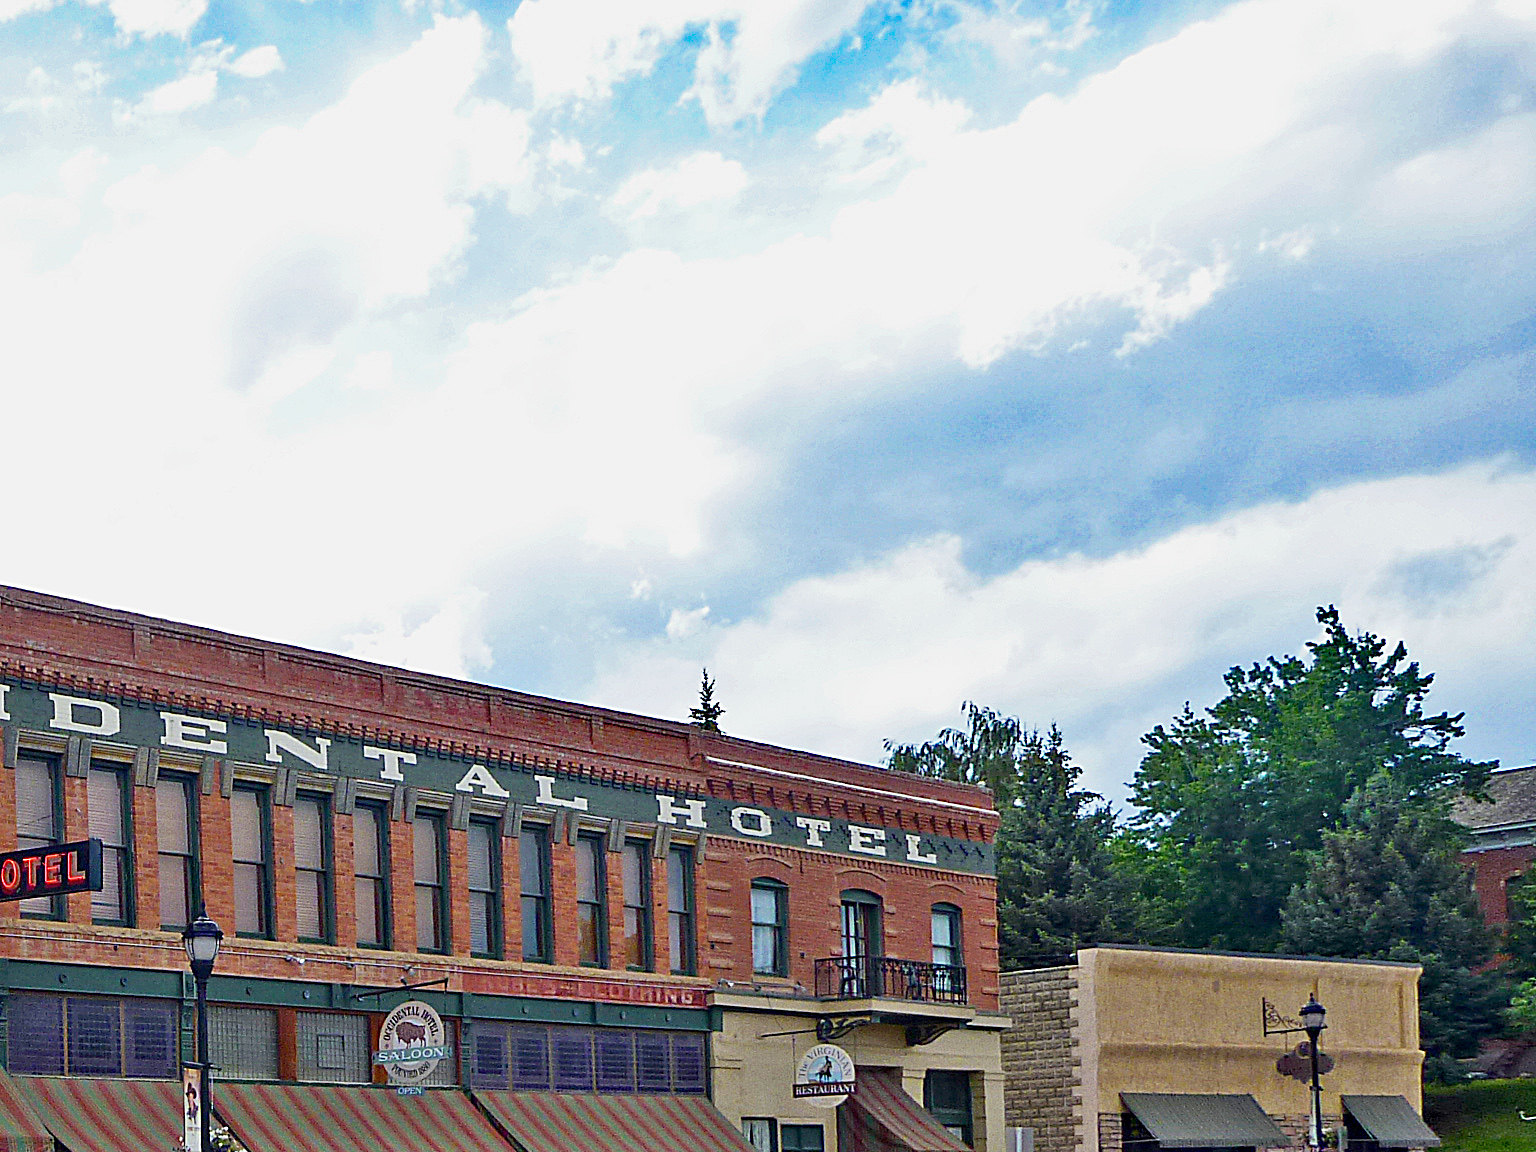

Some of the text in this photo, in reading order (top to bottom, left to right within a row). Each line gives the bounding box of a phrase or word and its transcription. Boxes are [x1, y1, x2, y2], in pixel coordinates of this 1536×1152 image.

[656, 795, 936, 864] HOTEL
[383, 1006, 439, 1041] OCCIDENTAL HOTEL
[378, 1047, 444, 1062] SALOON
[806, 1047, 852, 1077] VIRGINIAN
[398, 1087, 422, 1095] OPEN
[795, 1084, 856, 1095] RESTAURANT
